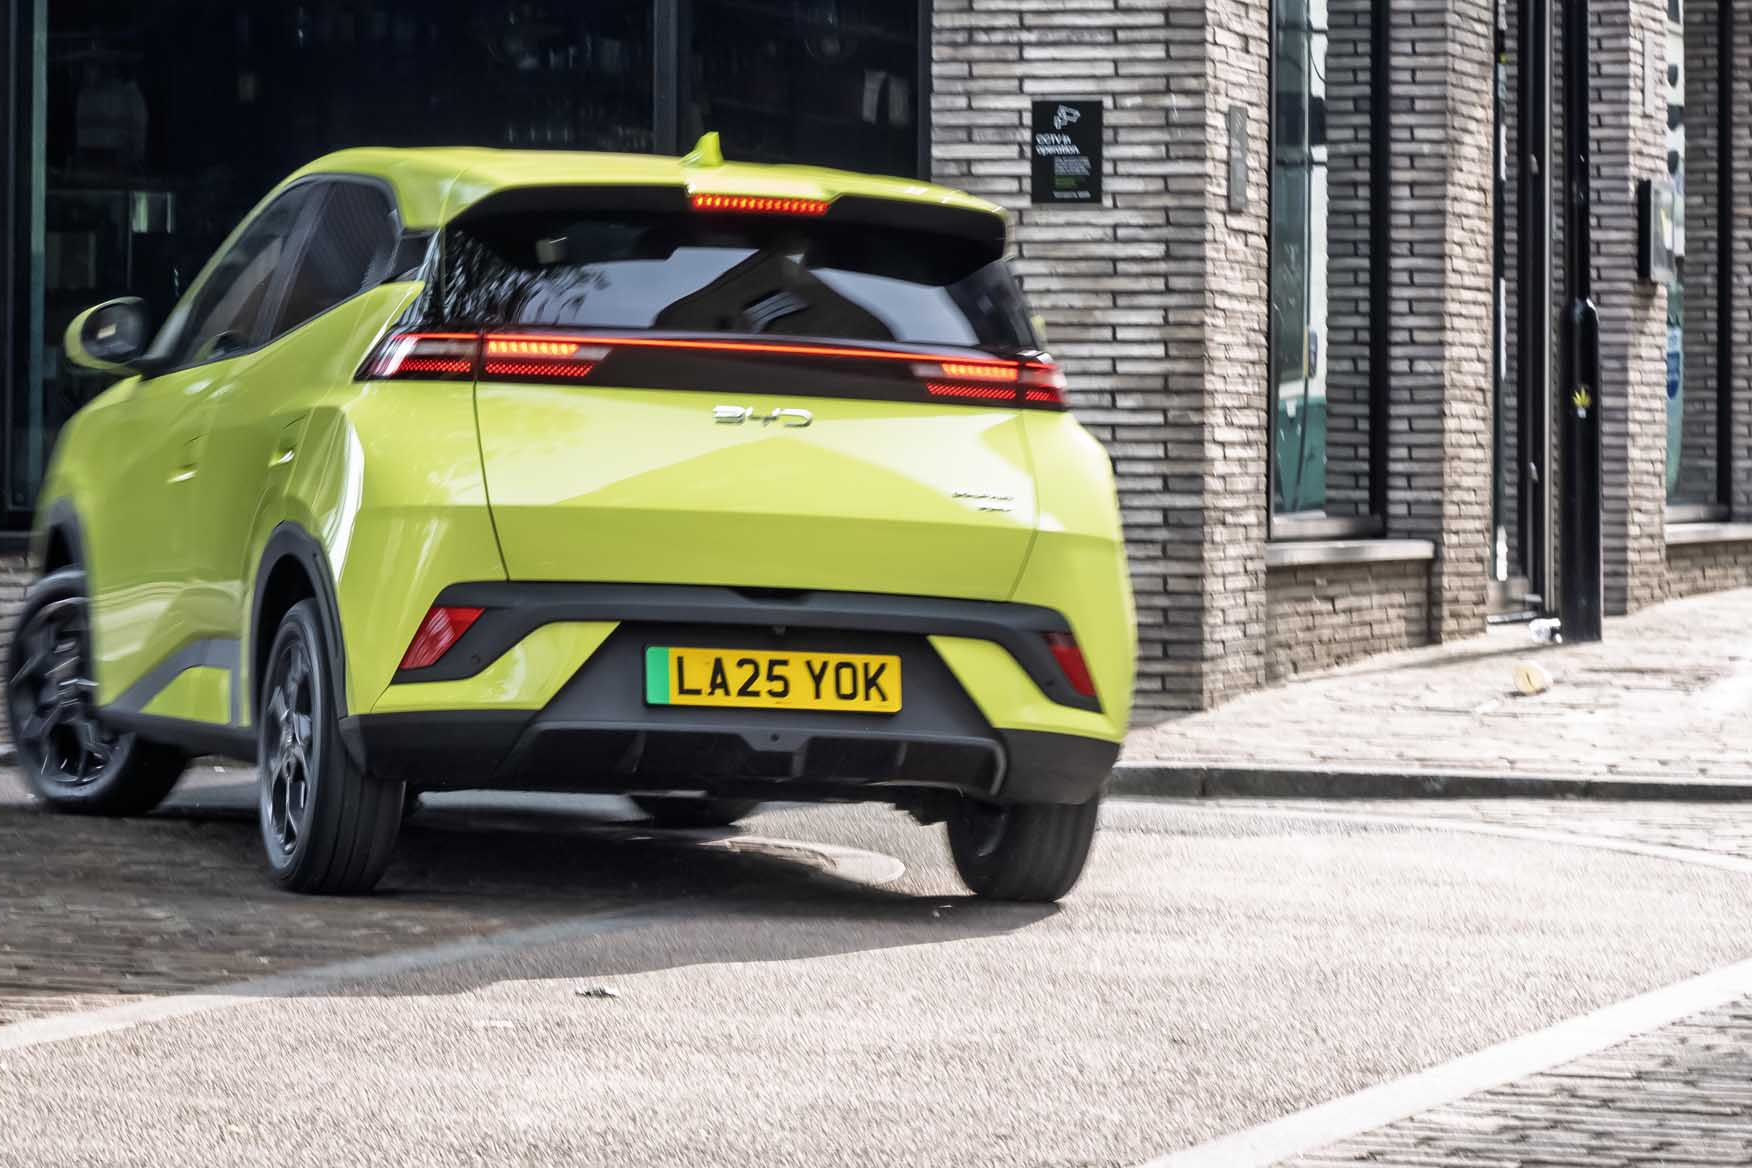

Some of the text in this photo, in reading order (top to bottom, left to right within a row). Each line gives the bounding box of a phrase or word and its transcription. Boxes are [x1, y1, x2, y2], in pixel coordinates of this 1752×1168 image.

[712, 404, 813, 428] BYD
[675, 654, 889, 703] LA25 YOK
